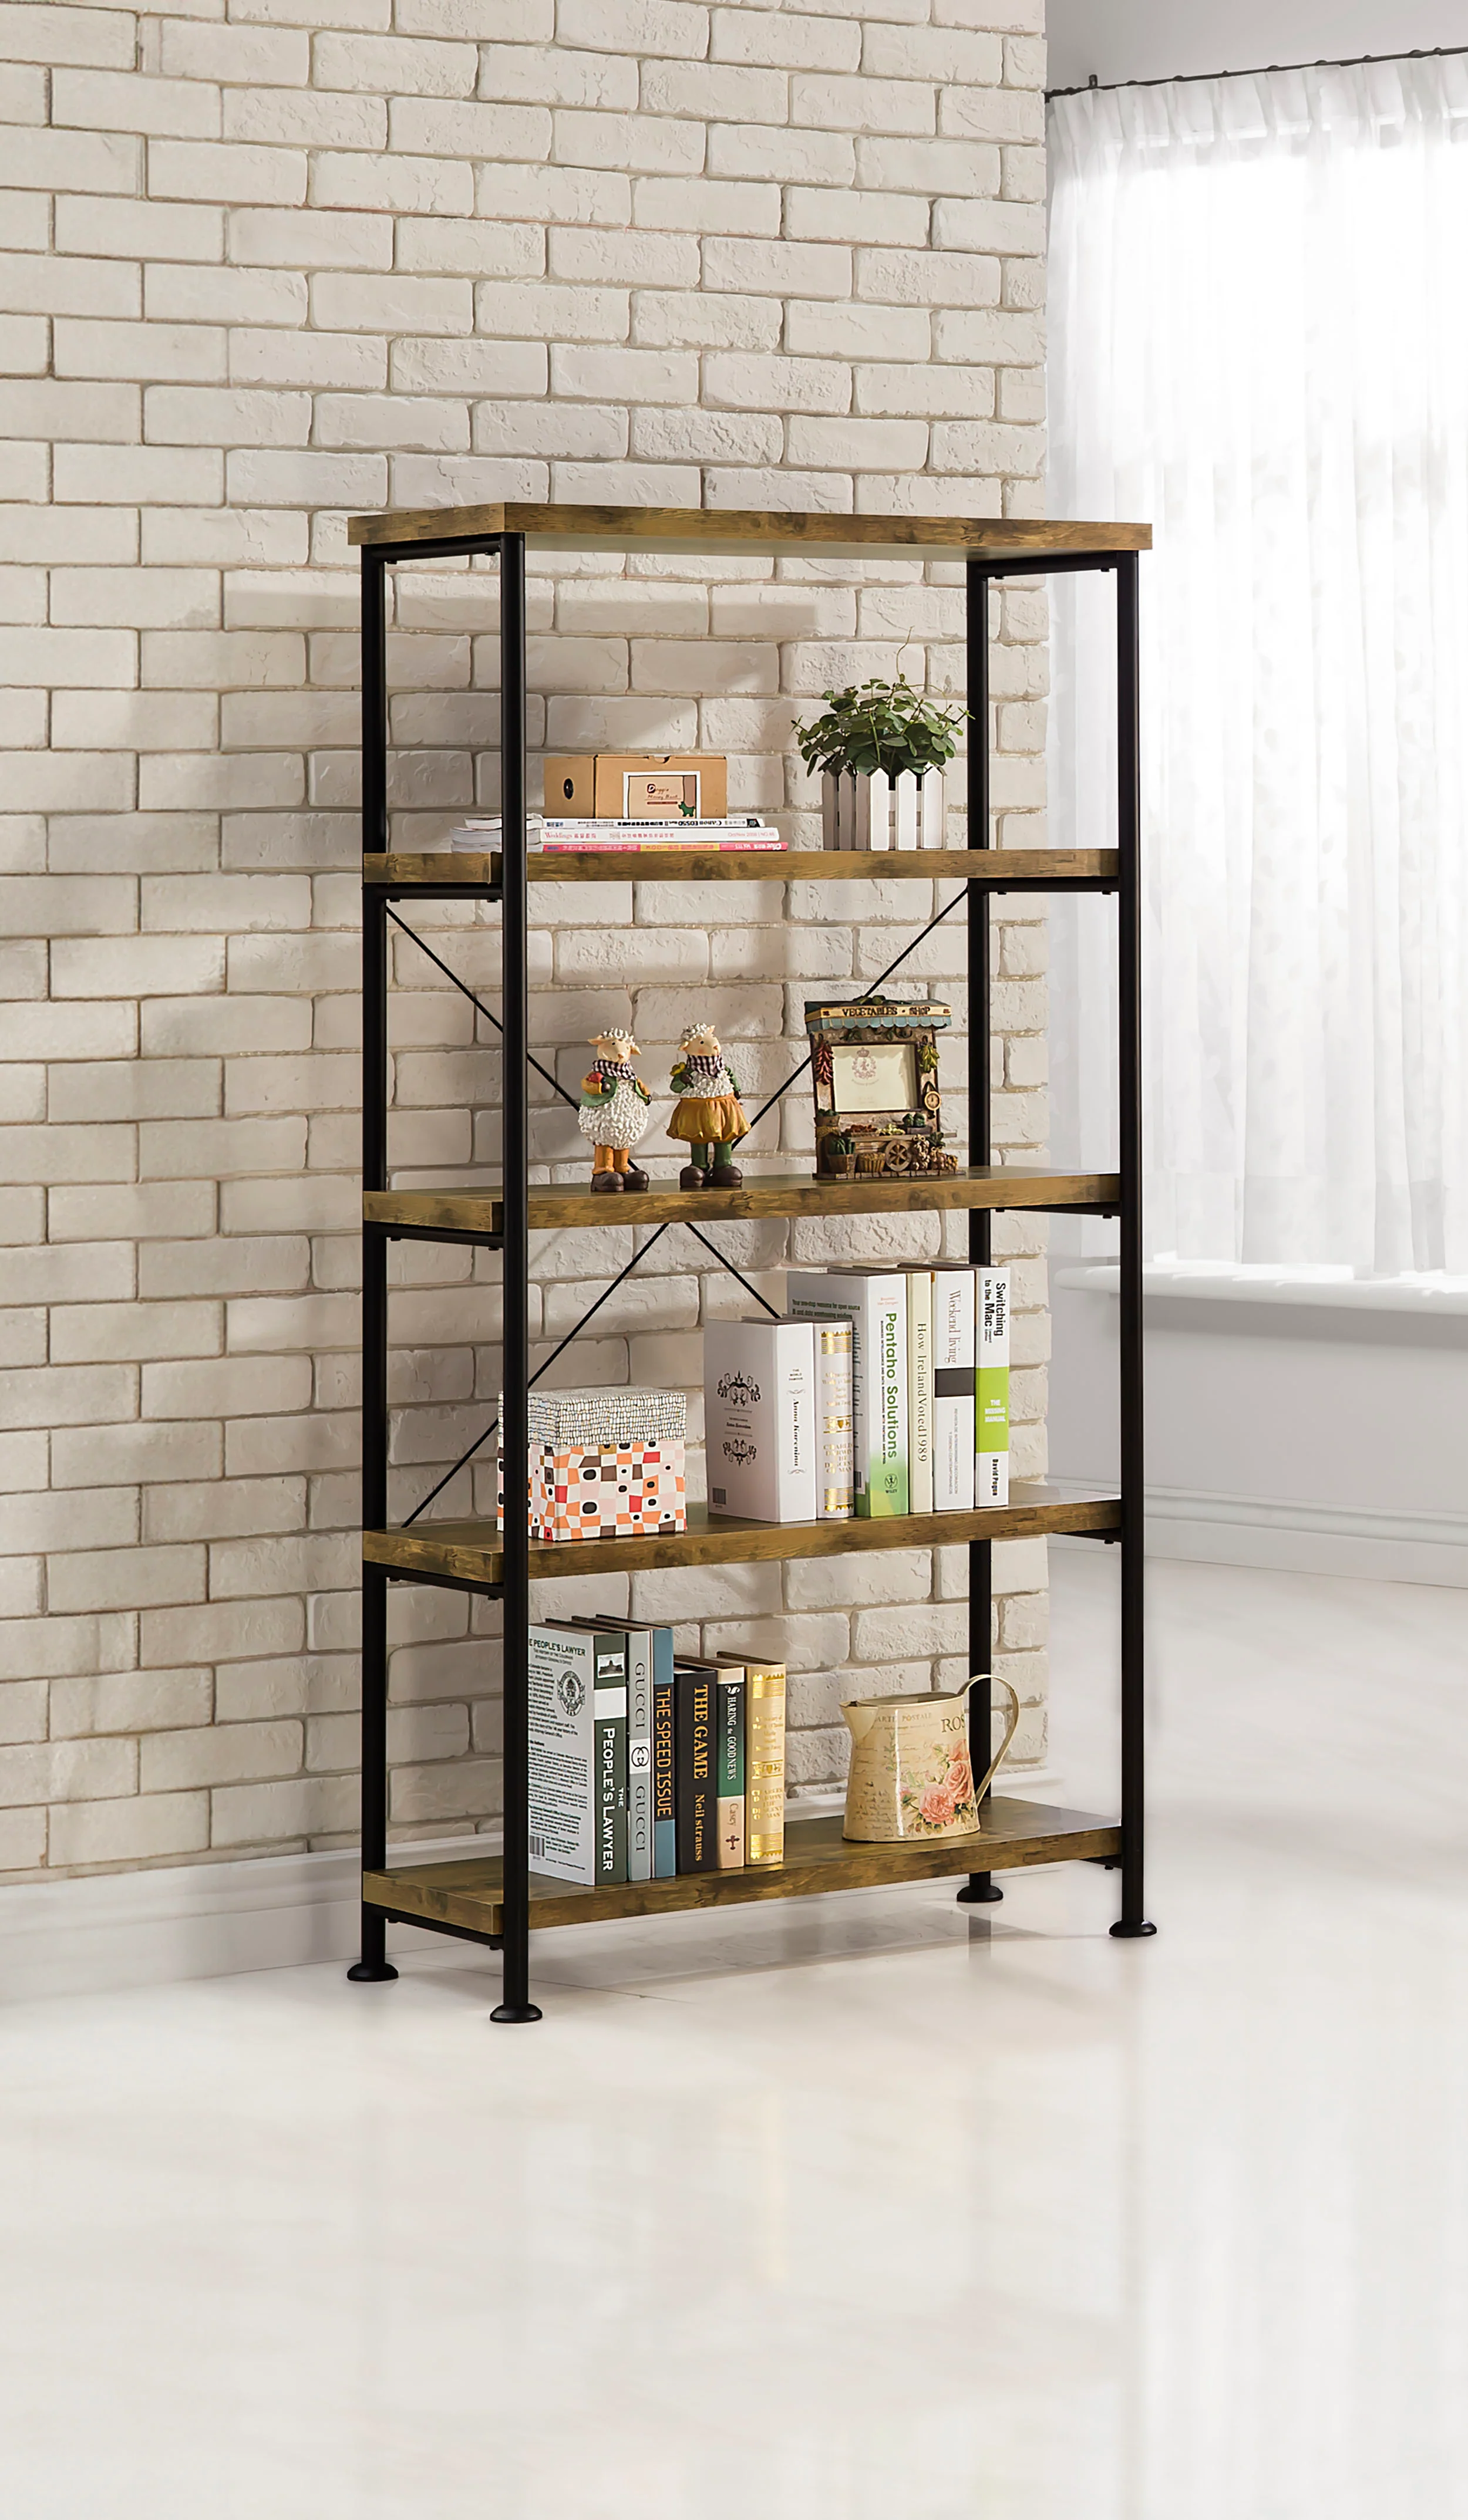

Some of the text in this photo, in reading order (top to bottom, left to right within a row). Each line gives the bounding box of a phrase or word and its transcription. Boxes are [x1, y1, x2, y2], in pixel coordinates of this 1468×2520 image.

[842, 1006, 931, 1017] VEGETABLES SHOP
[917, 1323, 927, 1350] How
[944, 1290, 961, 1363] Weekend living
[984, 1303, 995, 1327] Mac
[994, 1283, 1006, 1337] Switching
[885, 1313, 898, 1458] Pentaho Solutions
[533, 1639, 560, 1652] PEOPLE'S
[561, 1645, 585, 1657] LAWYER
[635, 1662, 645, 1728] GUCCI
[725, 1685, 740, 1726] SHARING
[656, 1688, 672, 1817] THE SPEED ISSUE
[693, 1684, 708, 1862] THE GAME Neil strauss
[602, 1728, 615, 1871] PEOPLE'S LAWYER
[635, 1786, 646, 1852] GUCCI
[727, 1803, 739, 1826] Casey
